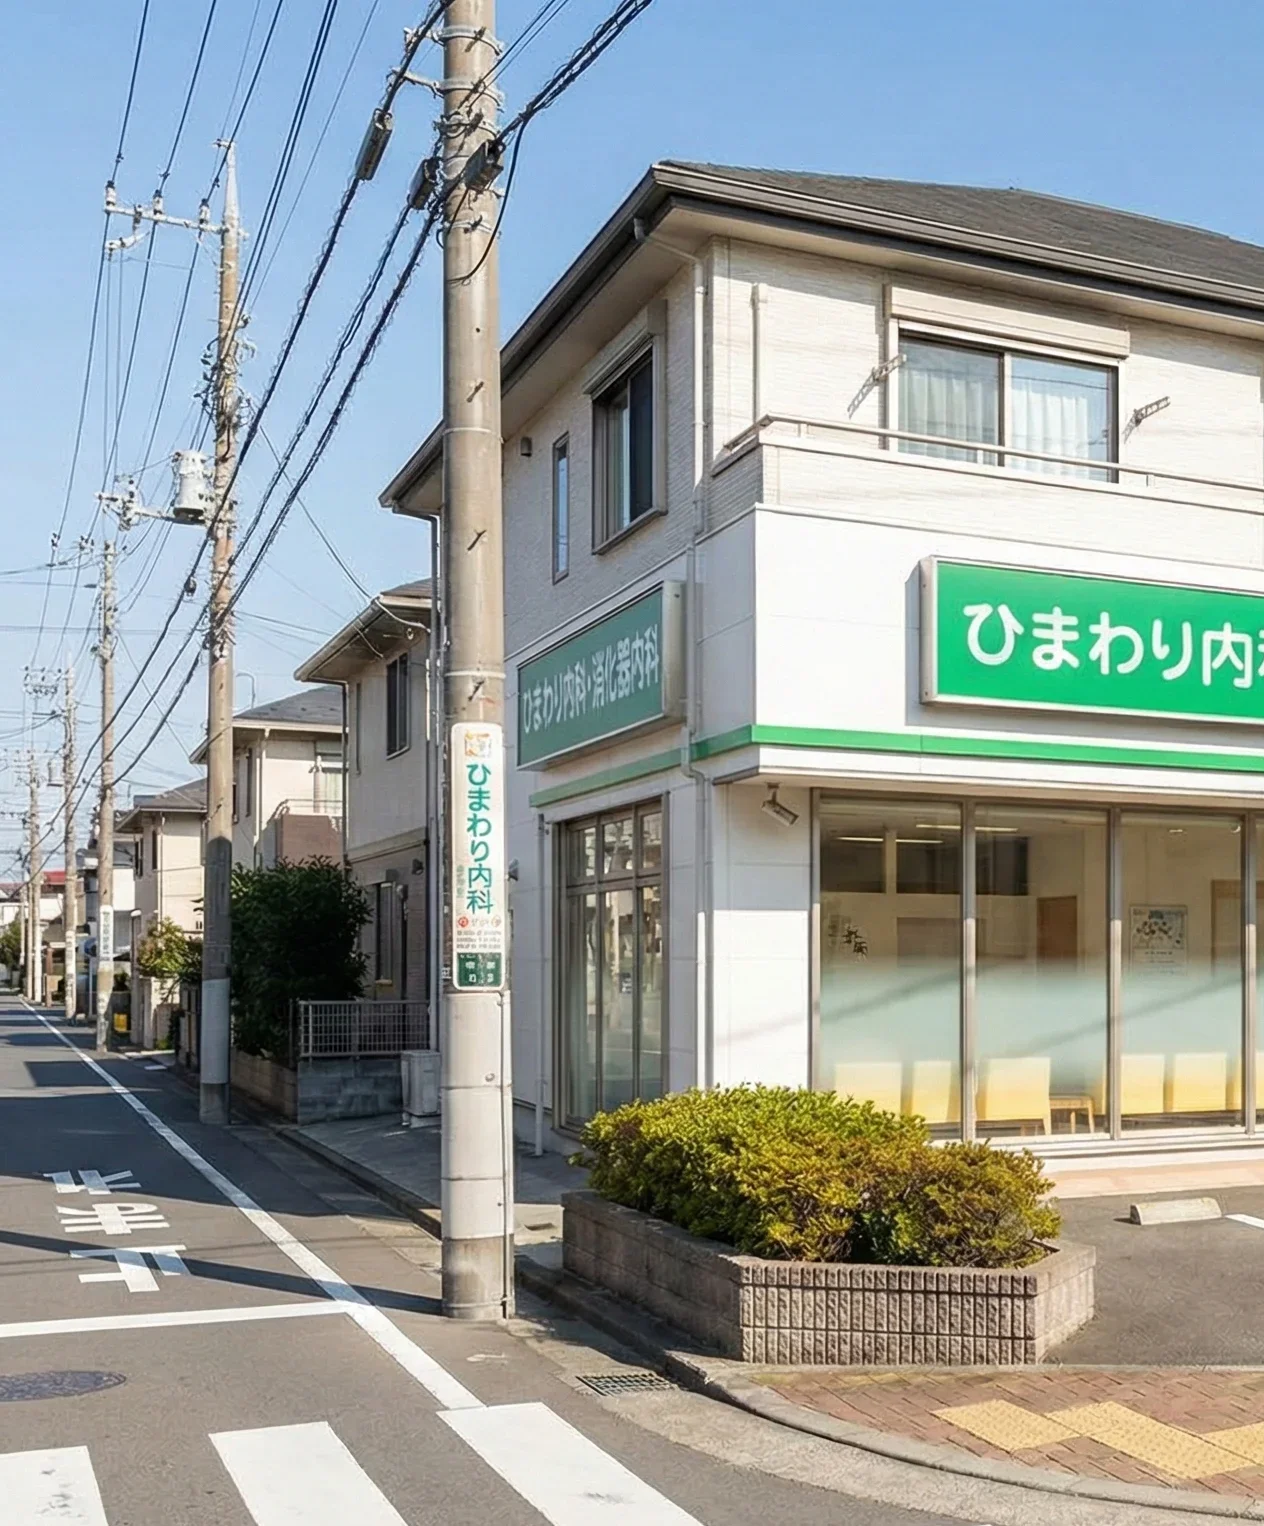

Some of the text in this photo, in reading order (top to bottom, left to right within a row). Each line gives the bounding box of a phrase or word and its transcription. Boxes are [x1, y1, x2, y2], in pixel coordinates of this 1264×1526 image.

[523, 624, 660, 736] ひまわり内科・消化器内科
[466, 763, 494, 915] ひまわり内科
